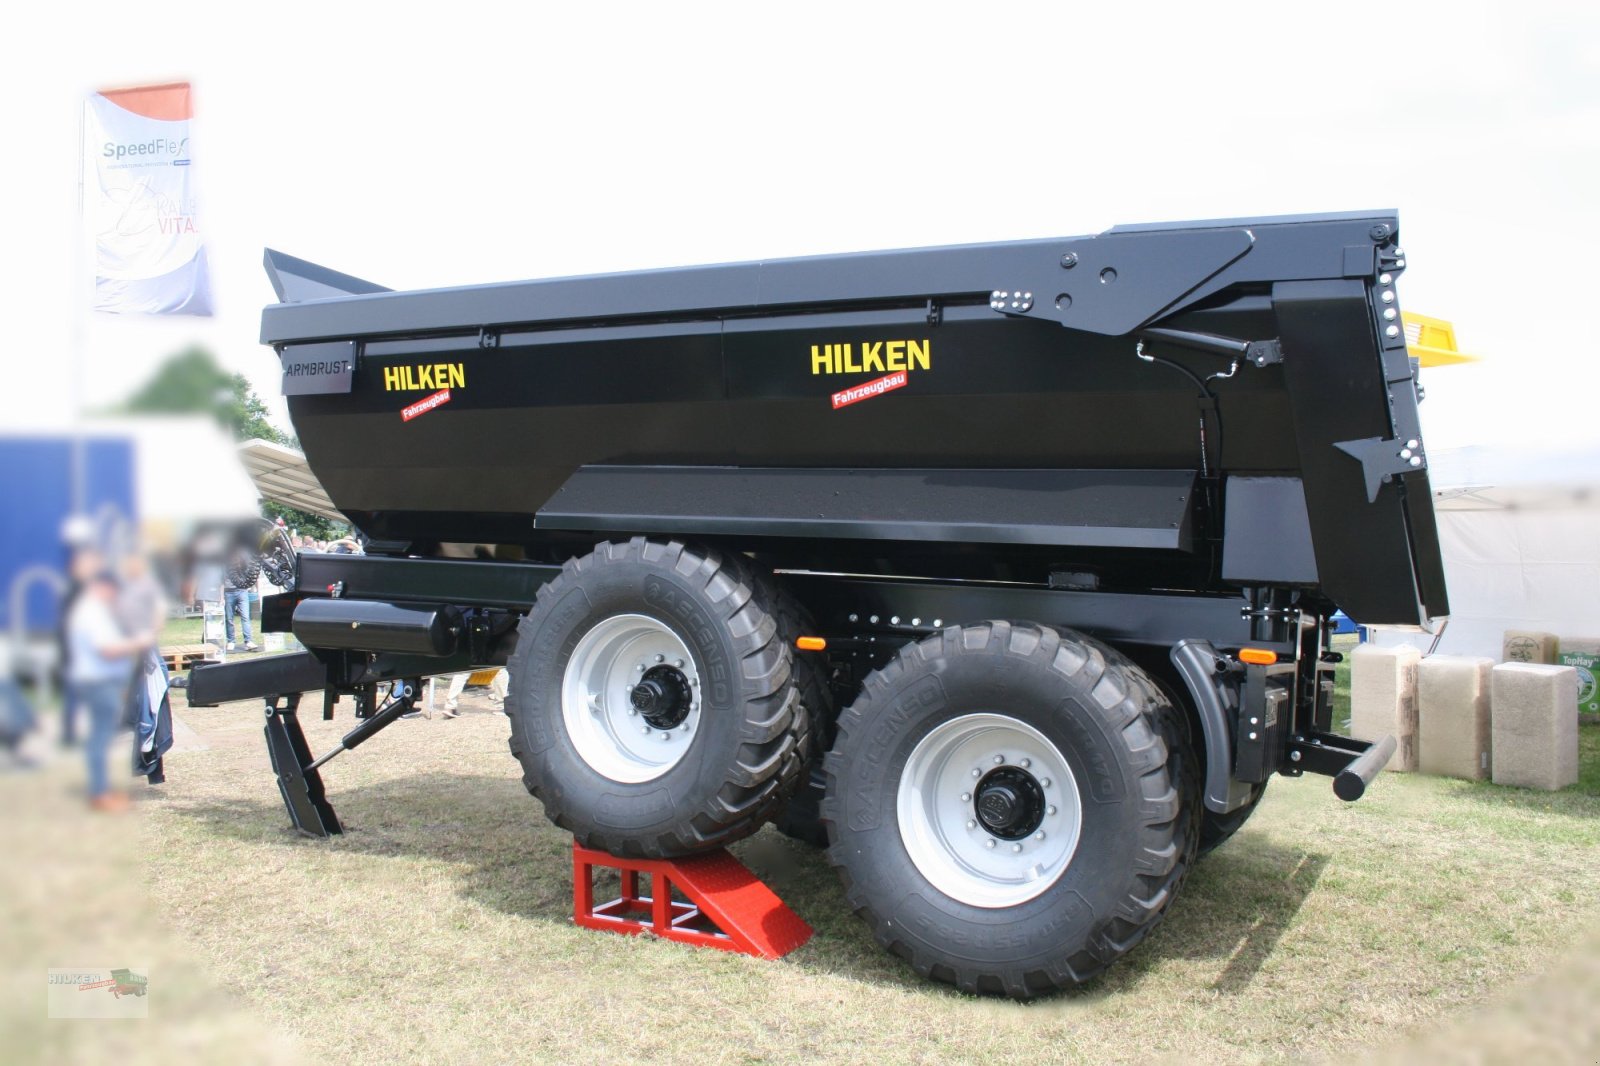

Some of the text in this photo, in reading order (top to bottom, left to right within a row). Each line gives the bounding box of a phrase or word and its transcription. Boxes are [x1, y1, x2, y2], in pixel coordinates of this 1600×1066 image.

[286, 360, 349, 377] ARMBRUST
[811, 340, 930, 374] HILKEN
[384, 363, 465, 391] HILKEN
[834, 374, 905, 405] Fahrzeugbau
[402, 391, 449, 419] Fahrzeugbau
[662, 585, 731, 703] ASCENSO
[1563, 655, 1594, 668] TopHay
[853, 682, 941, 806] ASCENSO
